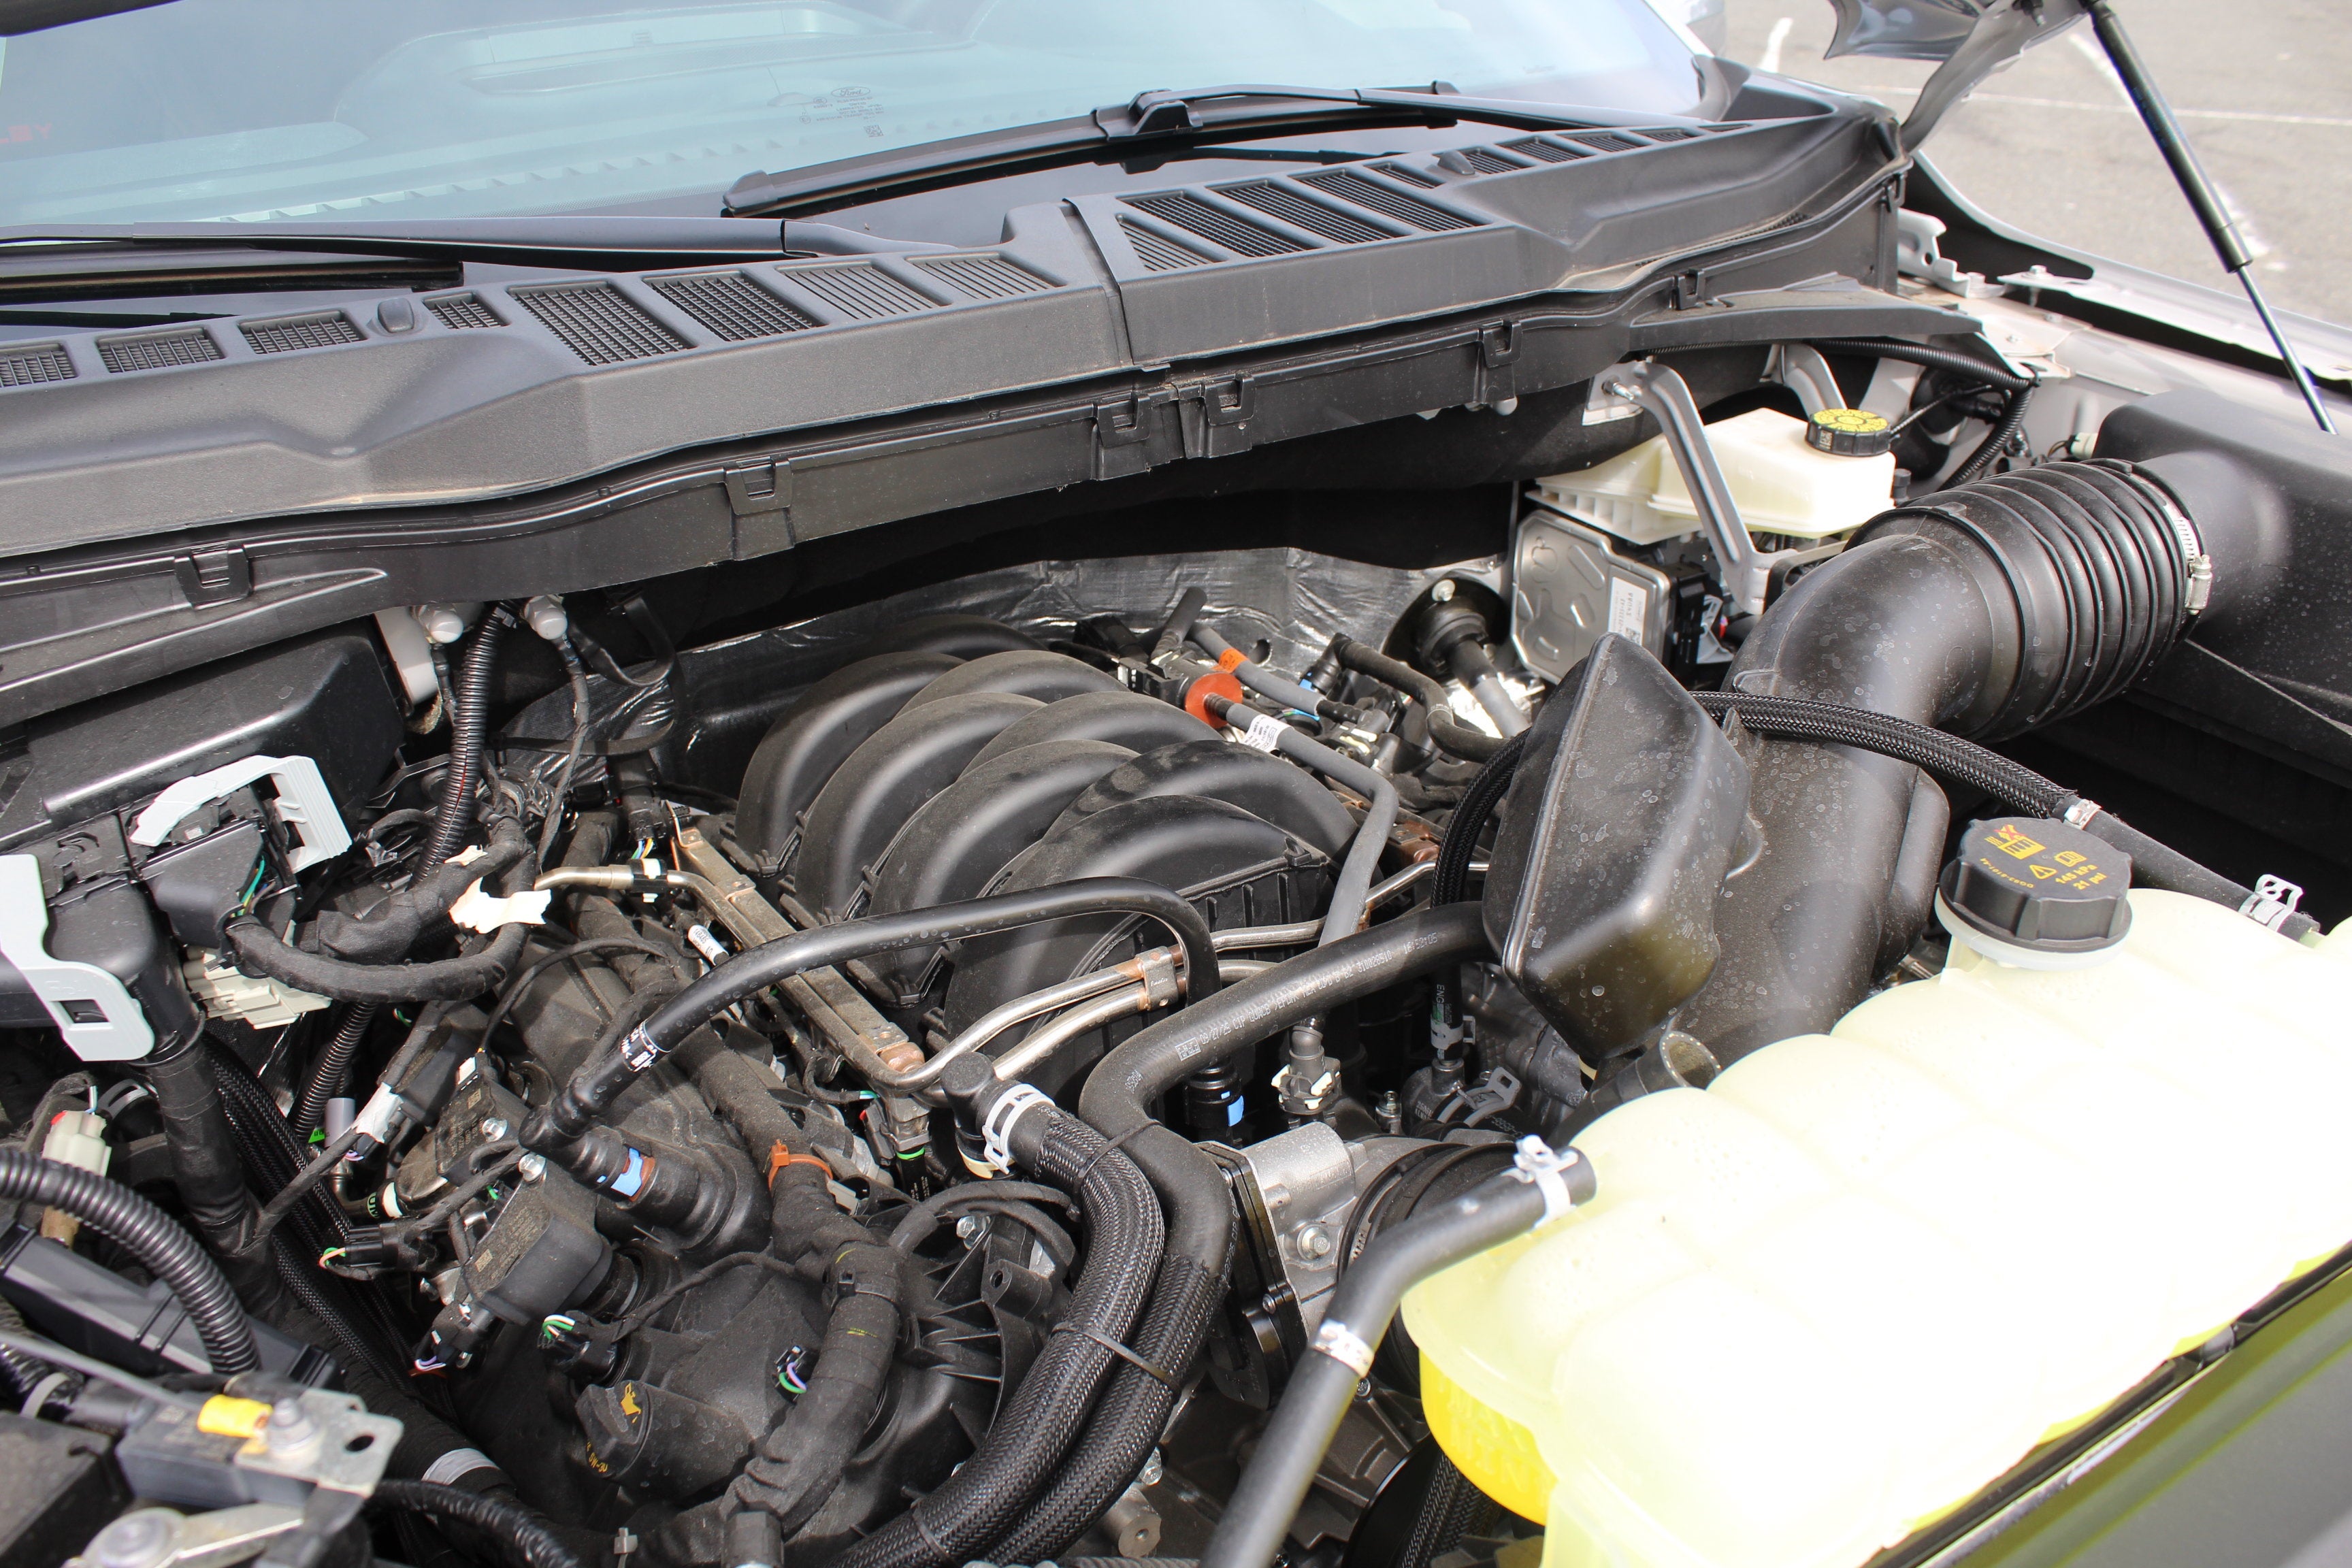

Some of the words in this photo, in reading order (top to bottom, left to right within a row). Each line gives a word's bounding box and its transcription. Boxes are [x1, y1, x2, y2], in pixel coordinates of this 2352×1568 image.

[2055, 871, 2078, 884] 145
[2074, 864, 2098, 877] kPa
[2073, 880, 2091, 890] 21
[2088, 872, 2108, 884] psi
[1436, 984, 1445, 1004] ENG
